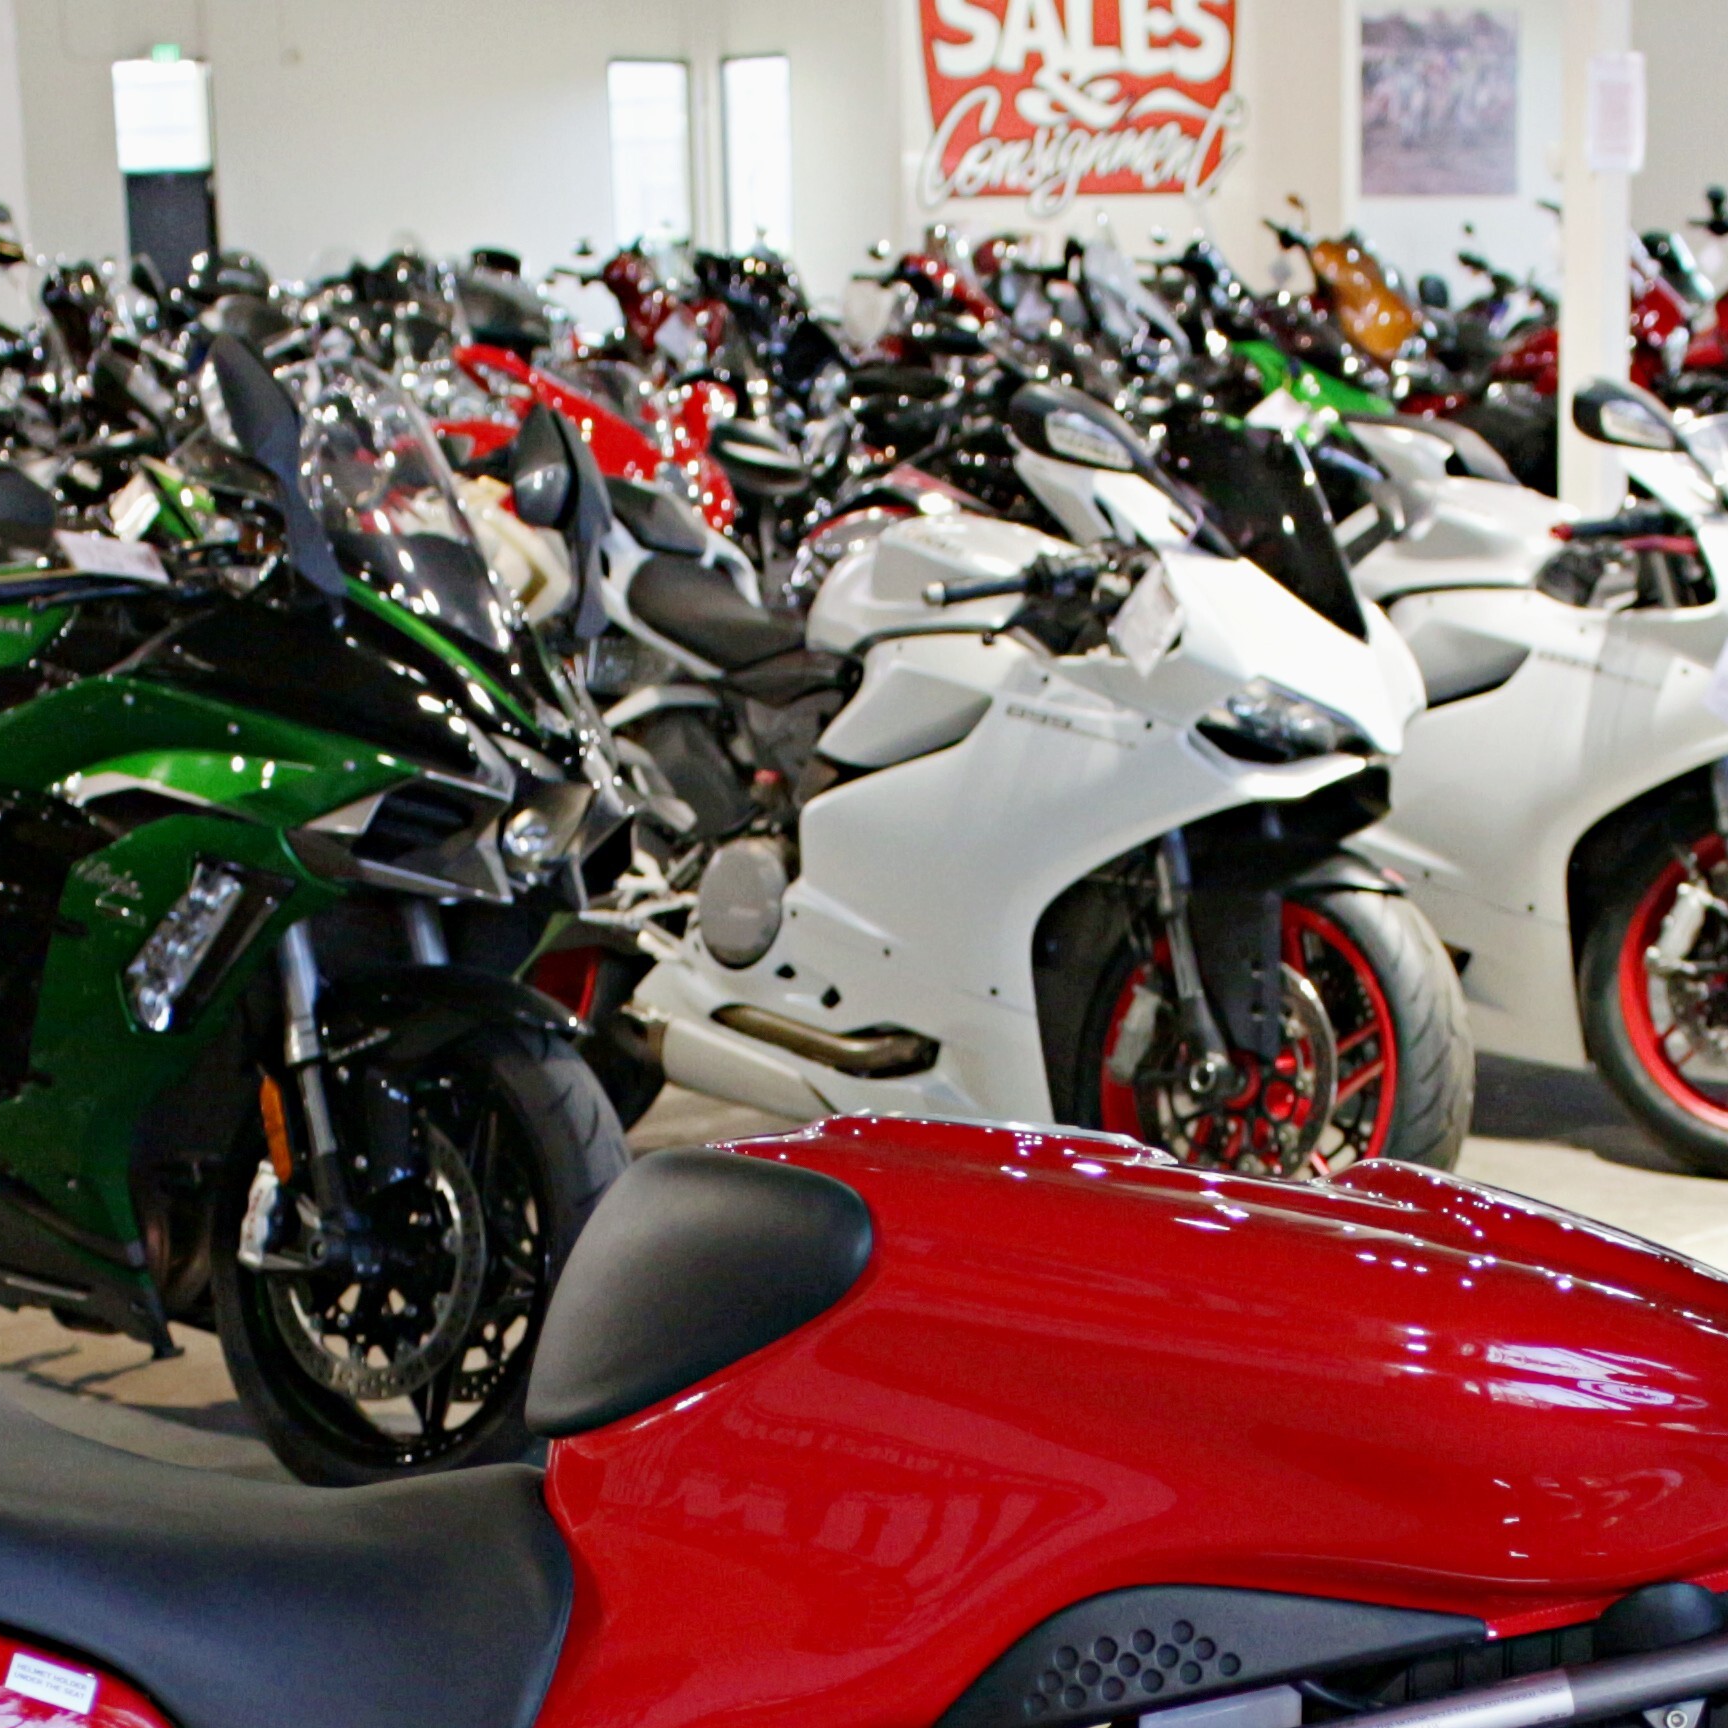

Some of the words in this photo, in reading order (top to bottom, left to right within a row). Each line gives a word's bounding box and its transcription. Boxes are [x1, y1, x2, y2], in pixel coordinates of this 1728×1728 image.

[932, 0, 1232, 83] SALES
[1015, 64, 1210, 129] &
[918, 85, 1246, 217] Consignment
